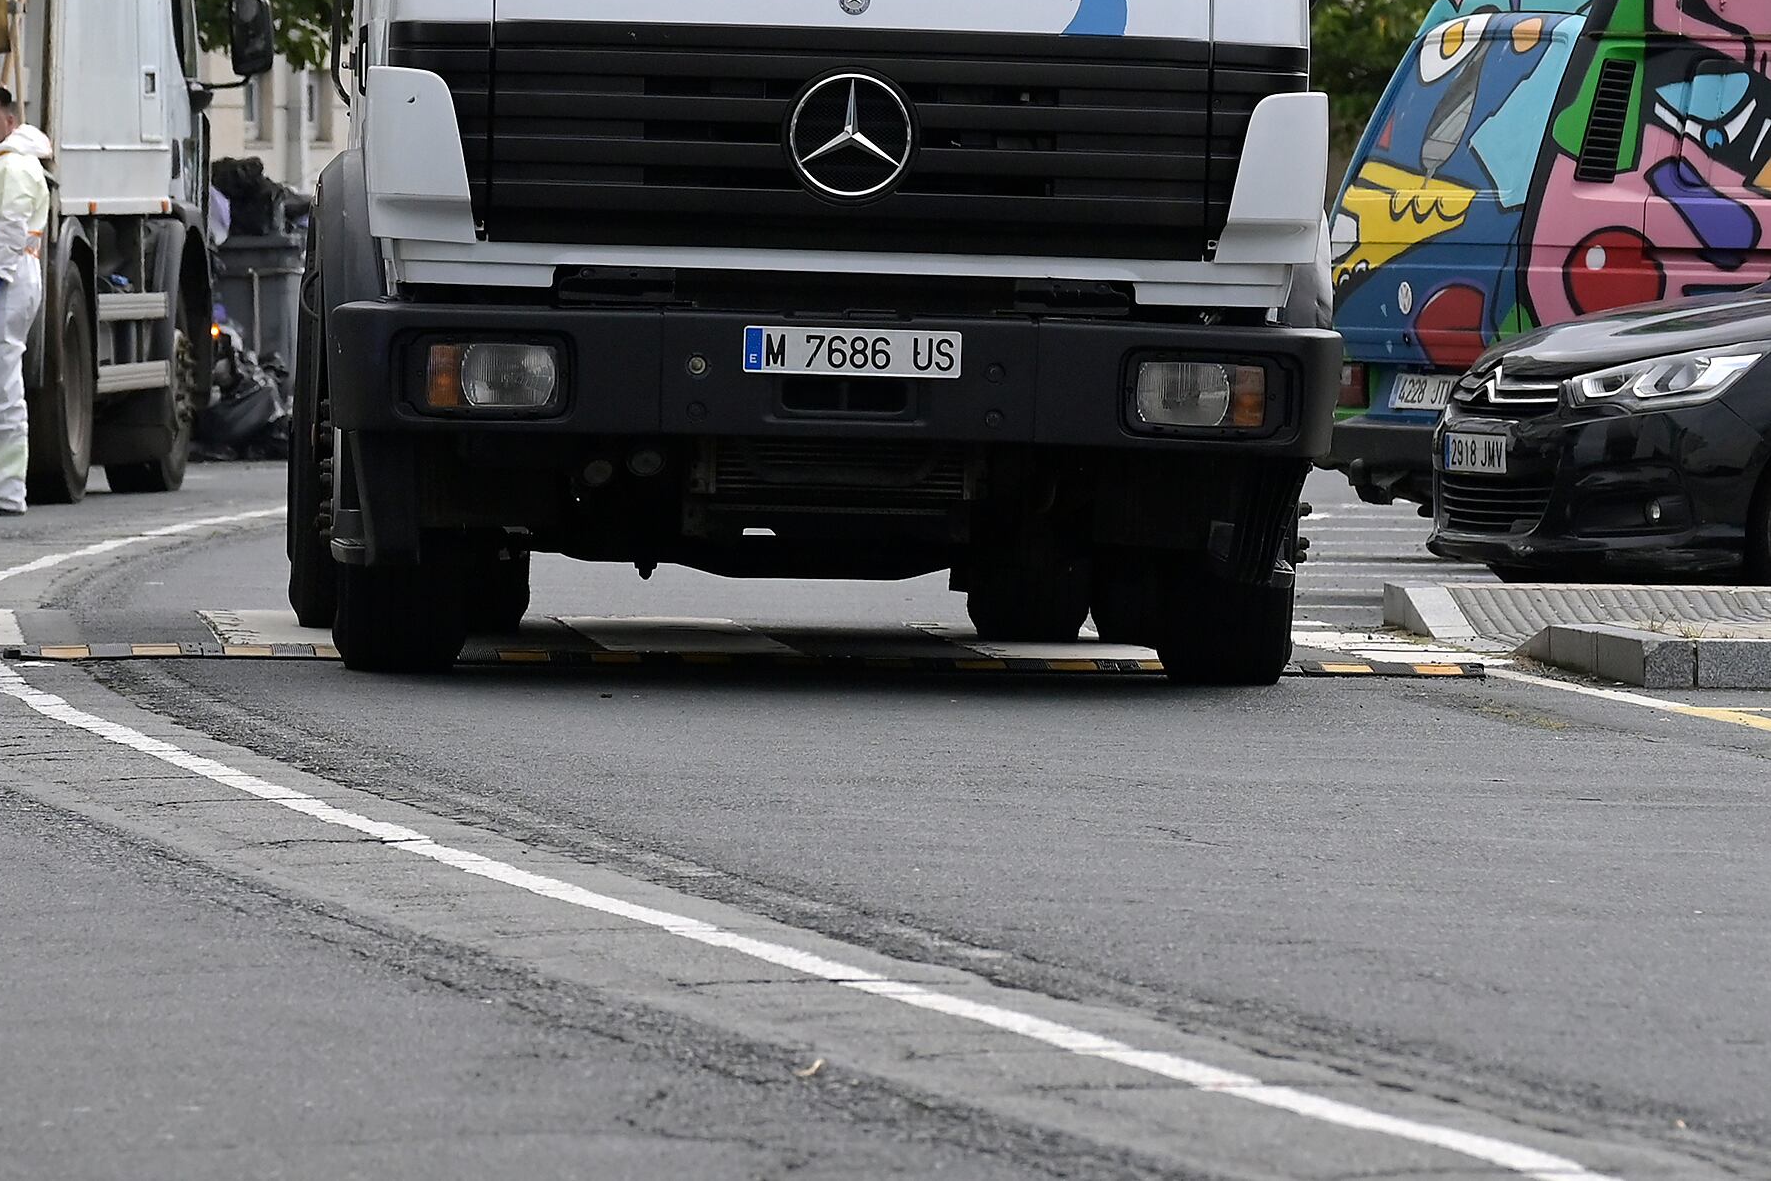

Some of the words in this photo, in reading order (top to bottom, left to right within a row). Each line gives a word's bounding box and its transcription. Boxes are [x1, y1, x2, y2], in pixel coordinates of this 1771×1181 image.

[749, 353, 758, 364] E
[765, 333, 786, 367] M
[805, 335, 891, 370] 7686
[912, 337, 955, 372] US
[1398, 379, 1427, 404] 4228
[1451, 439, 1477, 467] 2918
[1480, 440, 1503, 468] JMV
